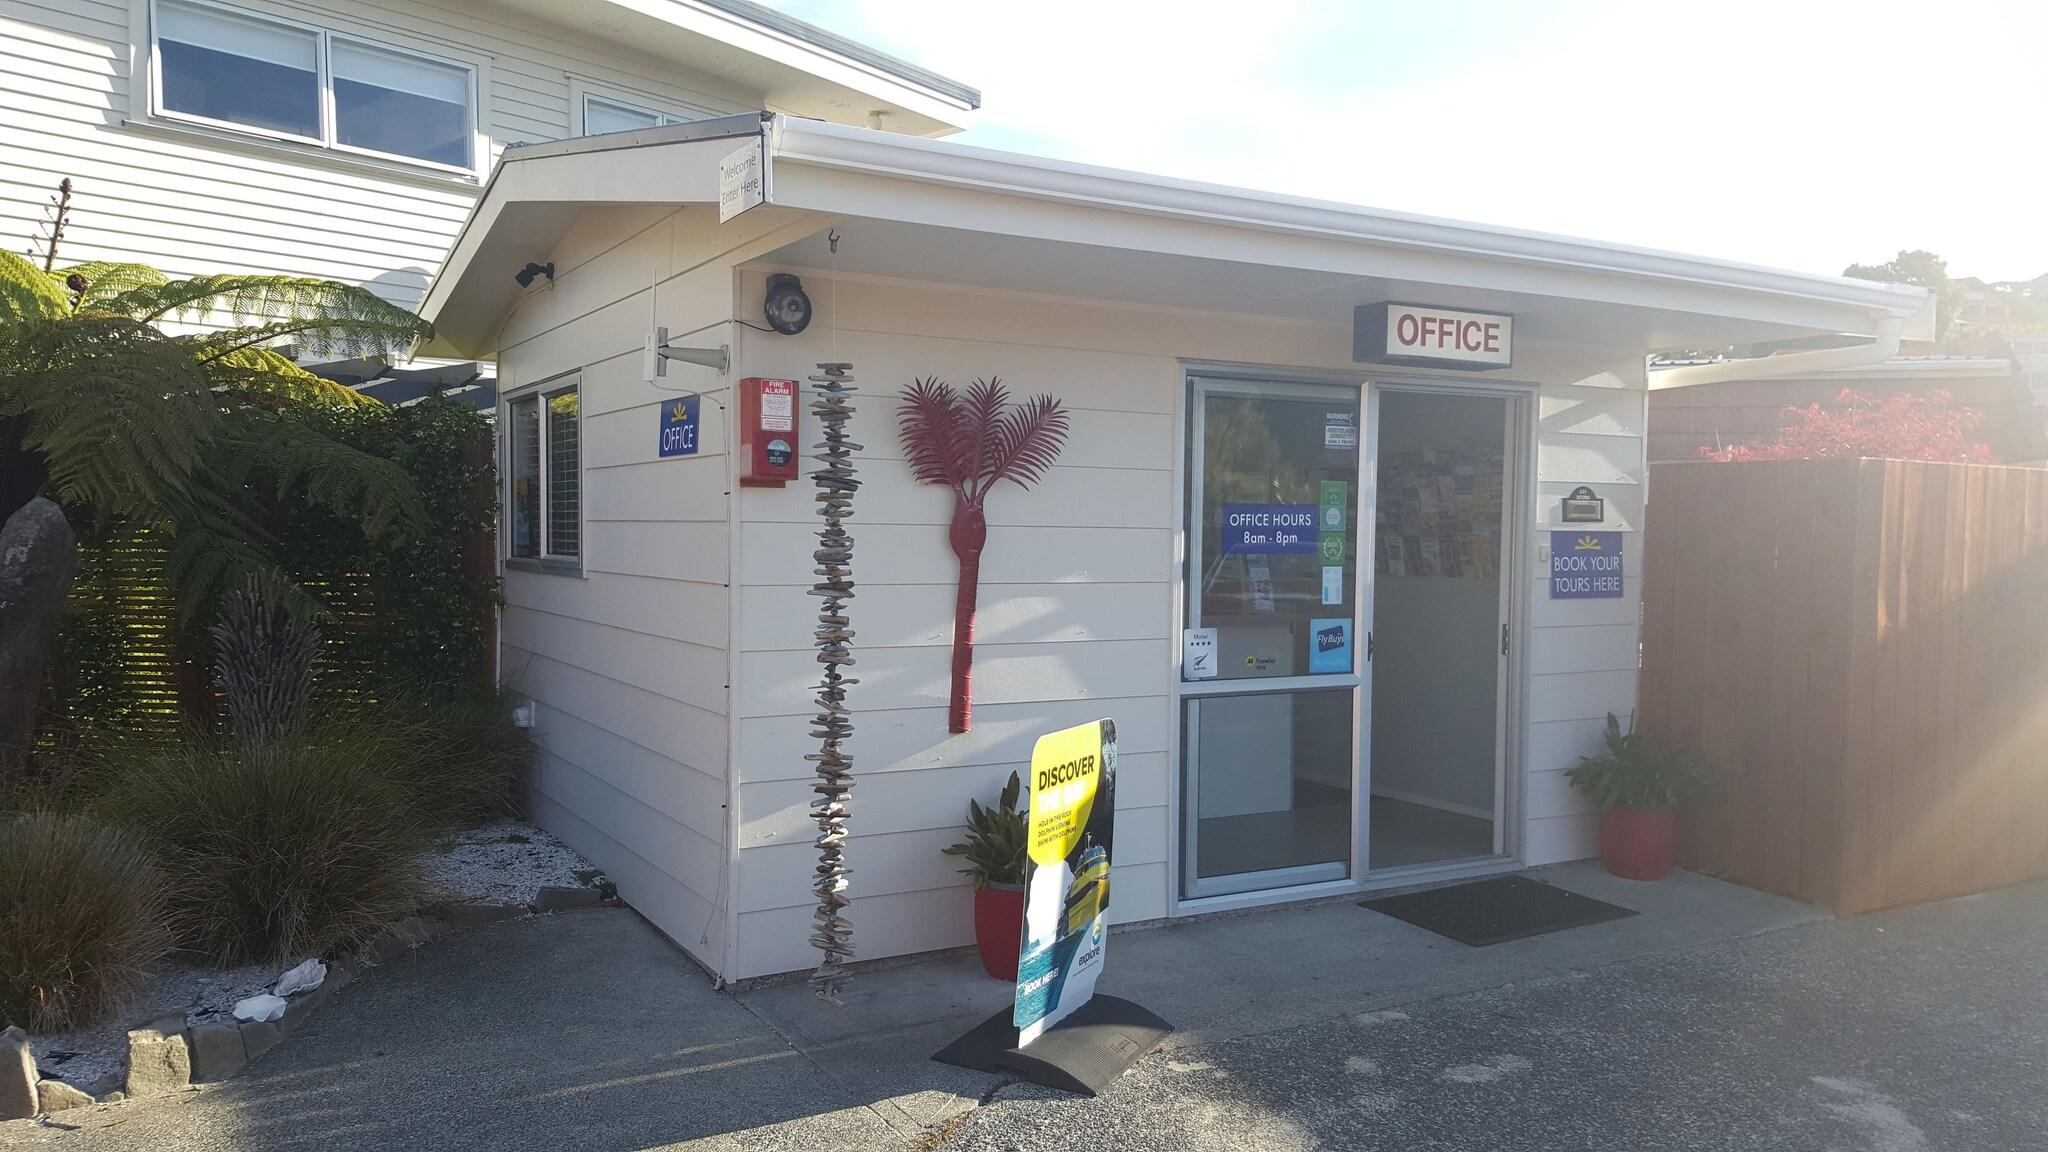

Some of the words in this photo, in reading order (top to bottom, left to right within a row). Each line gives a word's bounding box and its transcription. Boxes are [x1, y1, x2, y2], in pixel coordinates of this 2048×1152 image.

[724, 155, 757, 181] Welcome
[722, 187, 740, 206] Enter
[741, 178, 759, 195] Here
[1397, 313, 1500, 352] OFFICE
[764, 387, 790, 395] ALARM
[769, 381, 785, 389] FIRE
[663, 425, 694, 451] OFFICE
[1229, 513, 1269, 527] OFFICE
[1272, 513, 1312, 527] HOURS
[1243, 530, 1266, 544] 8am
[1276, 530, 1298, 547] 8pm
[1554, 556, 1588, 571] BOOK
[1590, 555, 1620, 571] YOUR
[1554, 577, 1591, 593] TOURS
[1593, 576, 1620, 592] HERE
[1039, 755, 1094, 791] DISCOVER
[1039, 819, 1049, 828] HOLE
[1079, 946, 1101, 967] explore
[1024, 977, 1042, 996] BOOK
